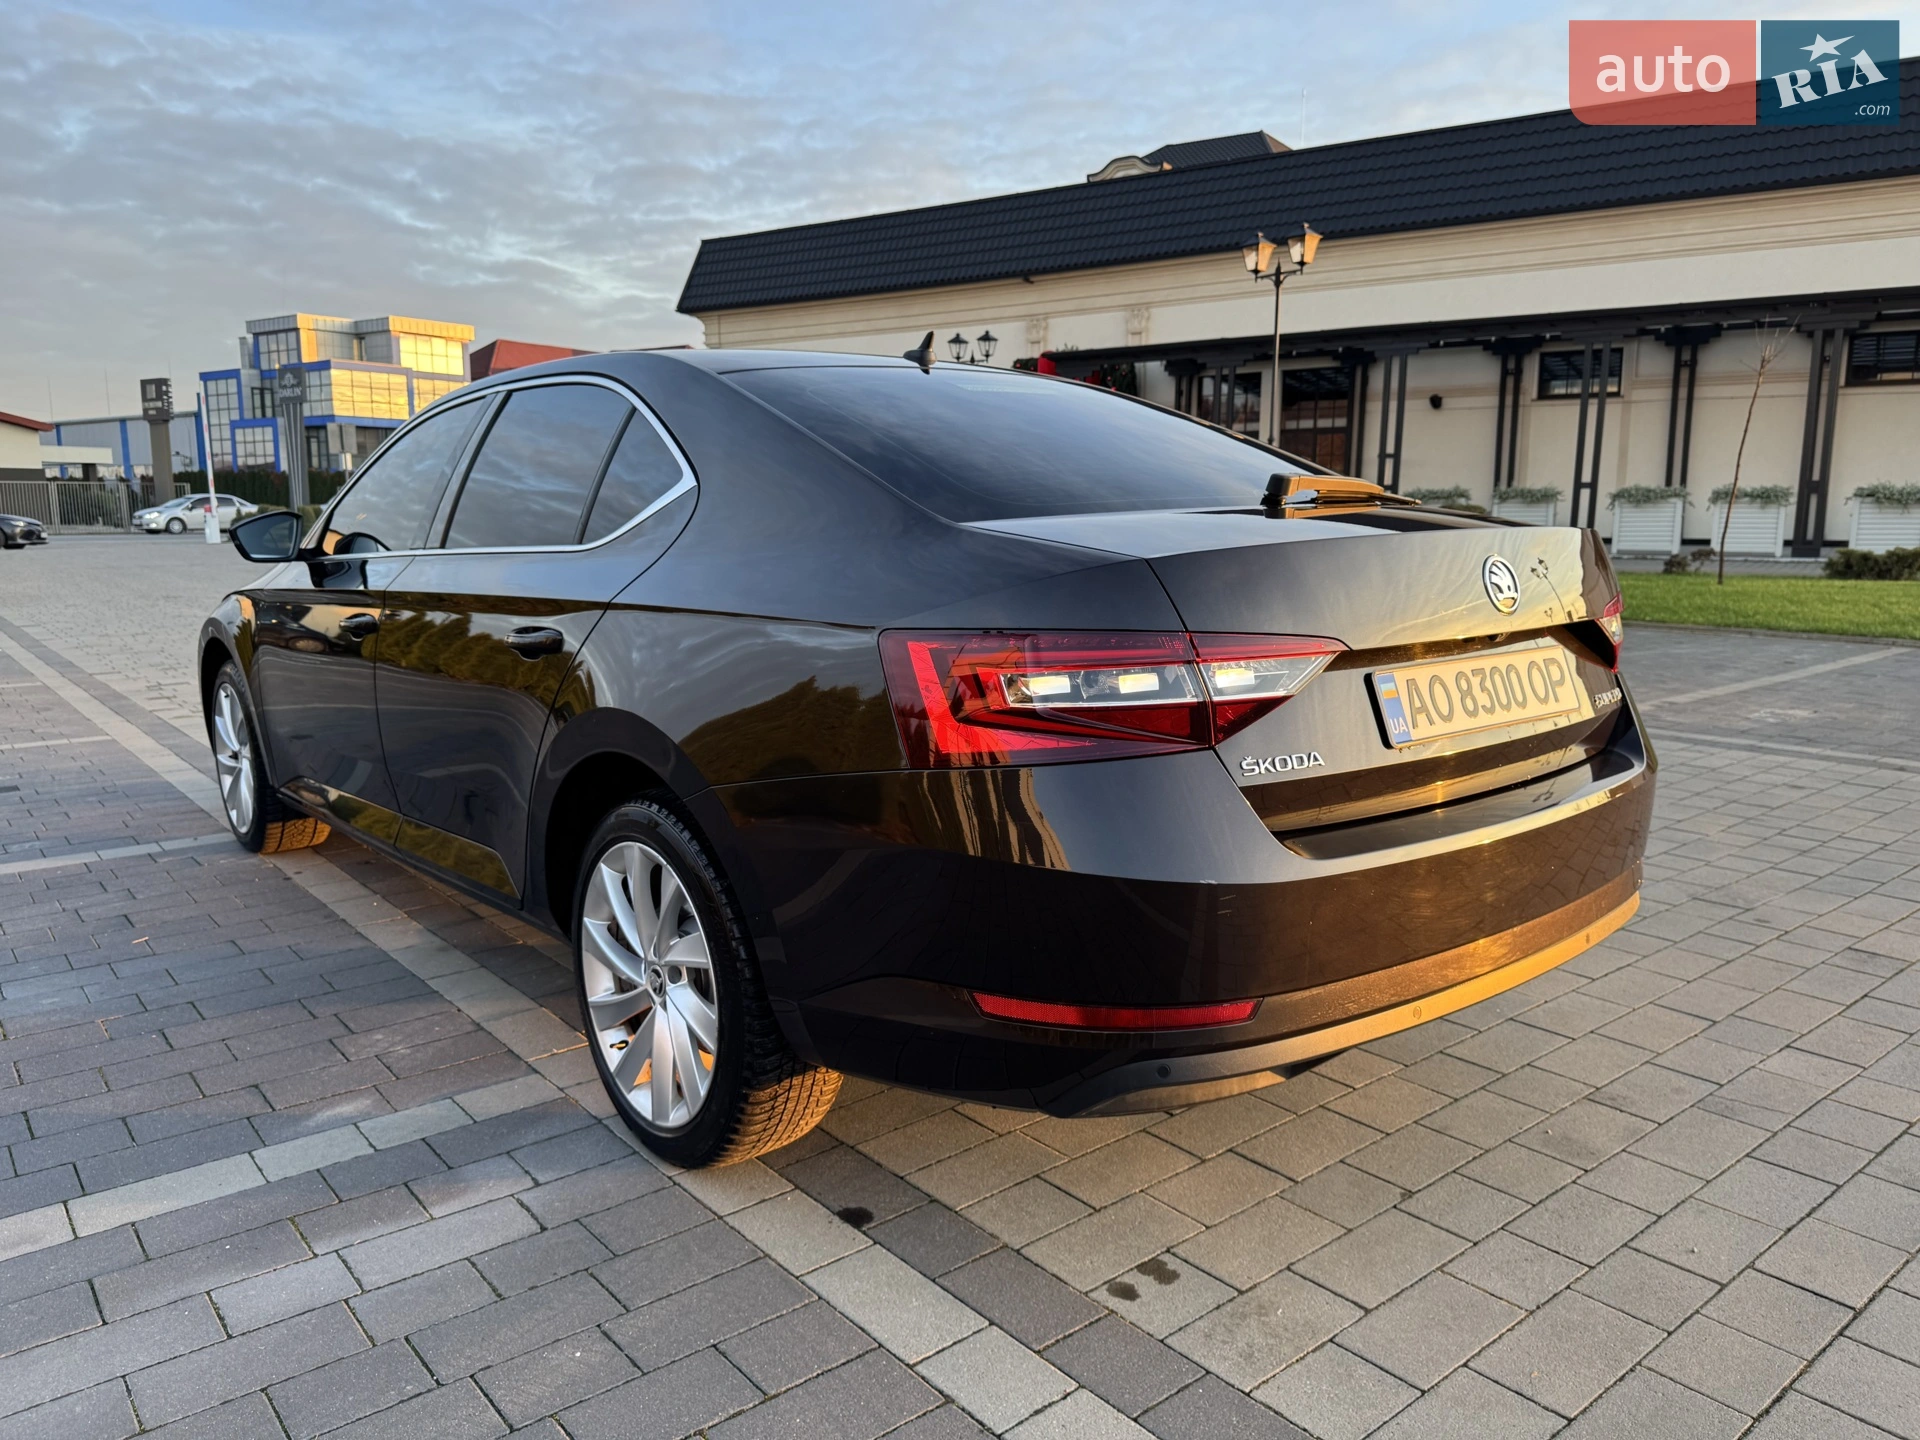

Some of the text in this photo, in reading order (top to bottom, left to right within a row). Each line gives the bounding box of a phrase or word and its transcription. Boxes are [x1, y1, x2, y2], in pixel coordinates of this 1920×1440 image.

[1405, 657, 1567, 730] AO 8300 OP
[1390, 716, 1409, 735] UA
[1240, 751, 1326, 777] ŠKODA
